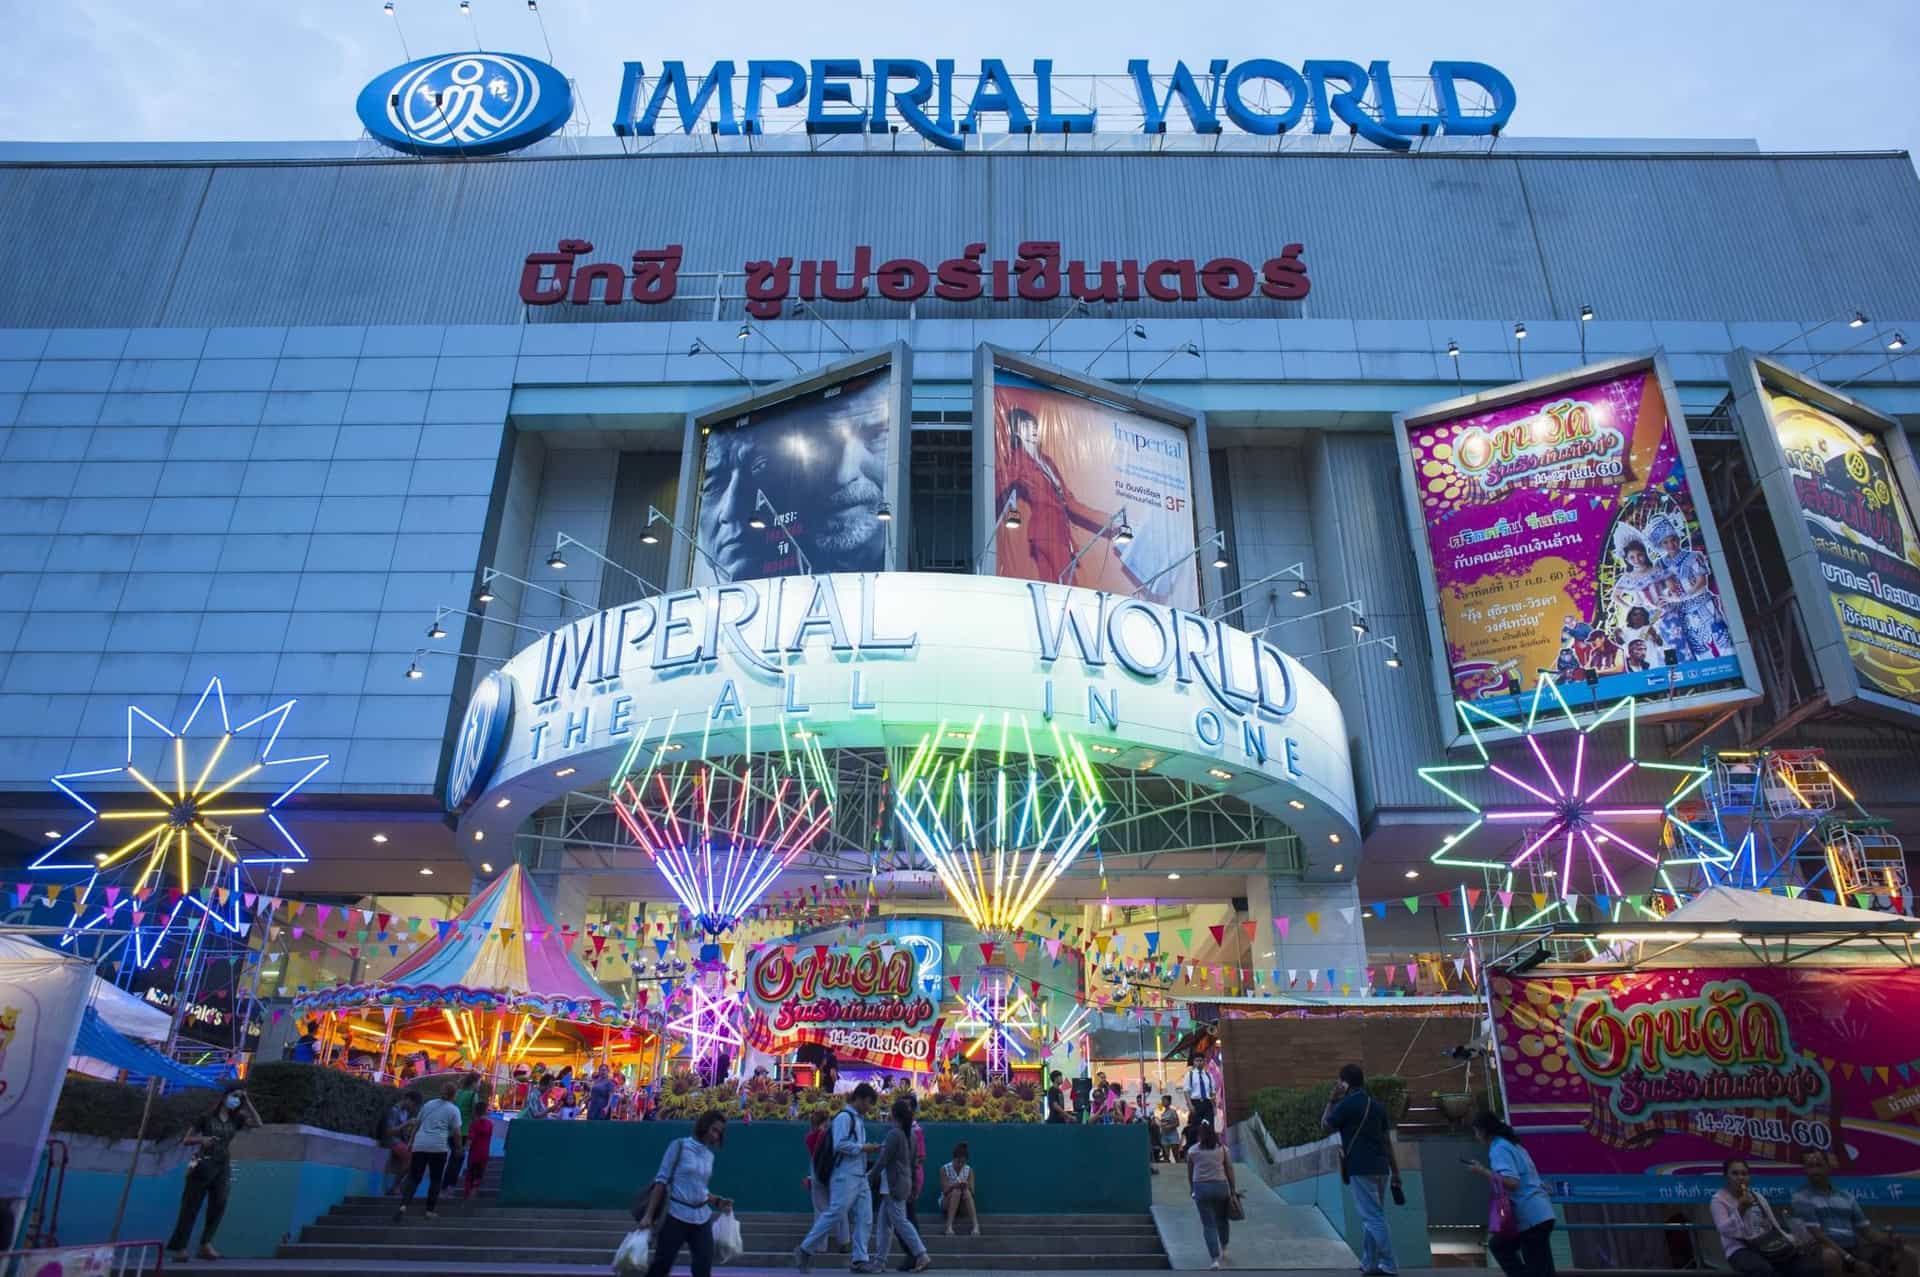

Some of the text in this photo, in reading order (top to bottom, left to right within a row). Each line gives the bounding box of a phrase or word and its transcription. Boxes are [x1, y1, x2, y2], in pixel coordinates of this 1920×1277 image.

[612, 58, 1516, 152] IMPERIAL WORLD
[1165, 495, 1185, 513] 3F
[532, 573, 1297, 716] IMPERIAL WORLD
[530, 671, 1305, 780] THE ALL IN ONE
[900, 1036, 929, 1058] 60
[1795, 1120, 1831, 1150] 60
